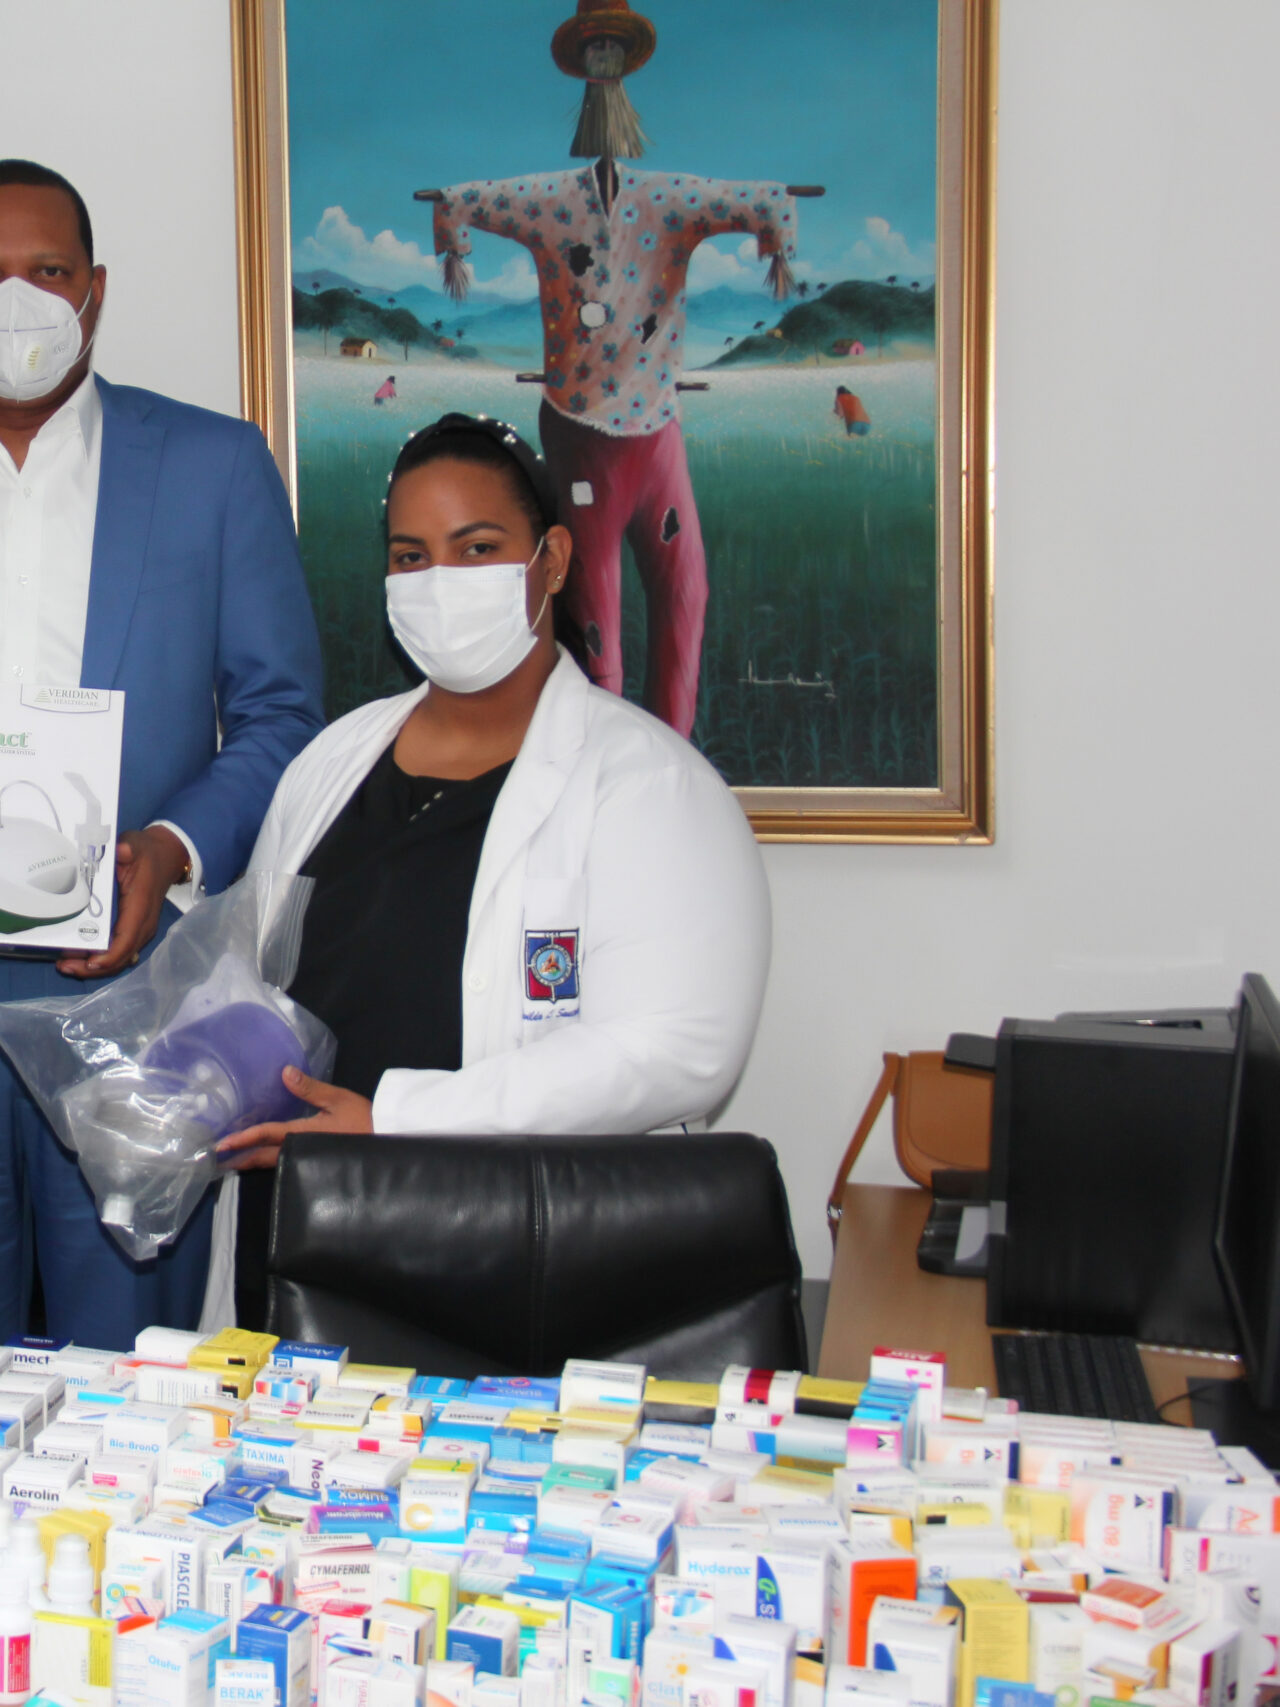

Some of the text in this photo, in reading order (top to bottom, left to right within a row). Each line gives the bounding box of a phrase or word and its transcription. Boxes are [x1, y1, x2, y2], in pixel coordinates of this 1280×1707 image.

[48, 688, 99, 700] VERIDIAN
[311, 1459, 324, 1490] Neo
[9, 1485, 60, 1502] Aerolin
